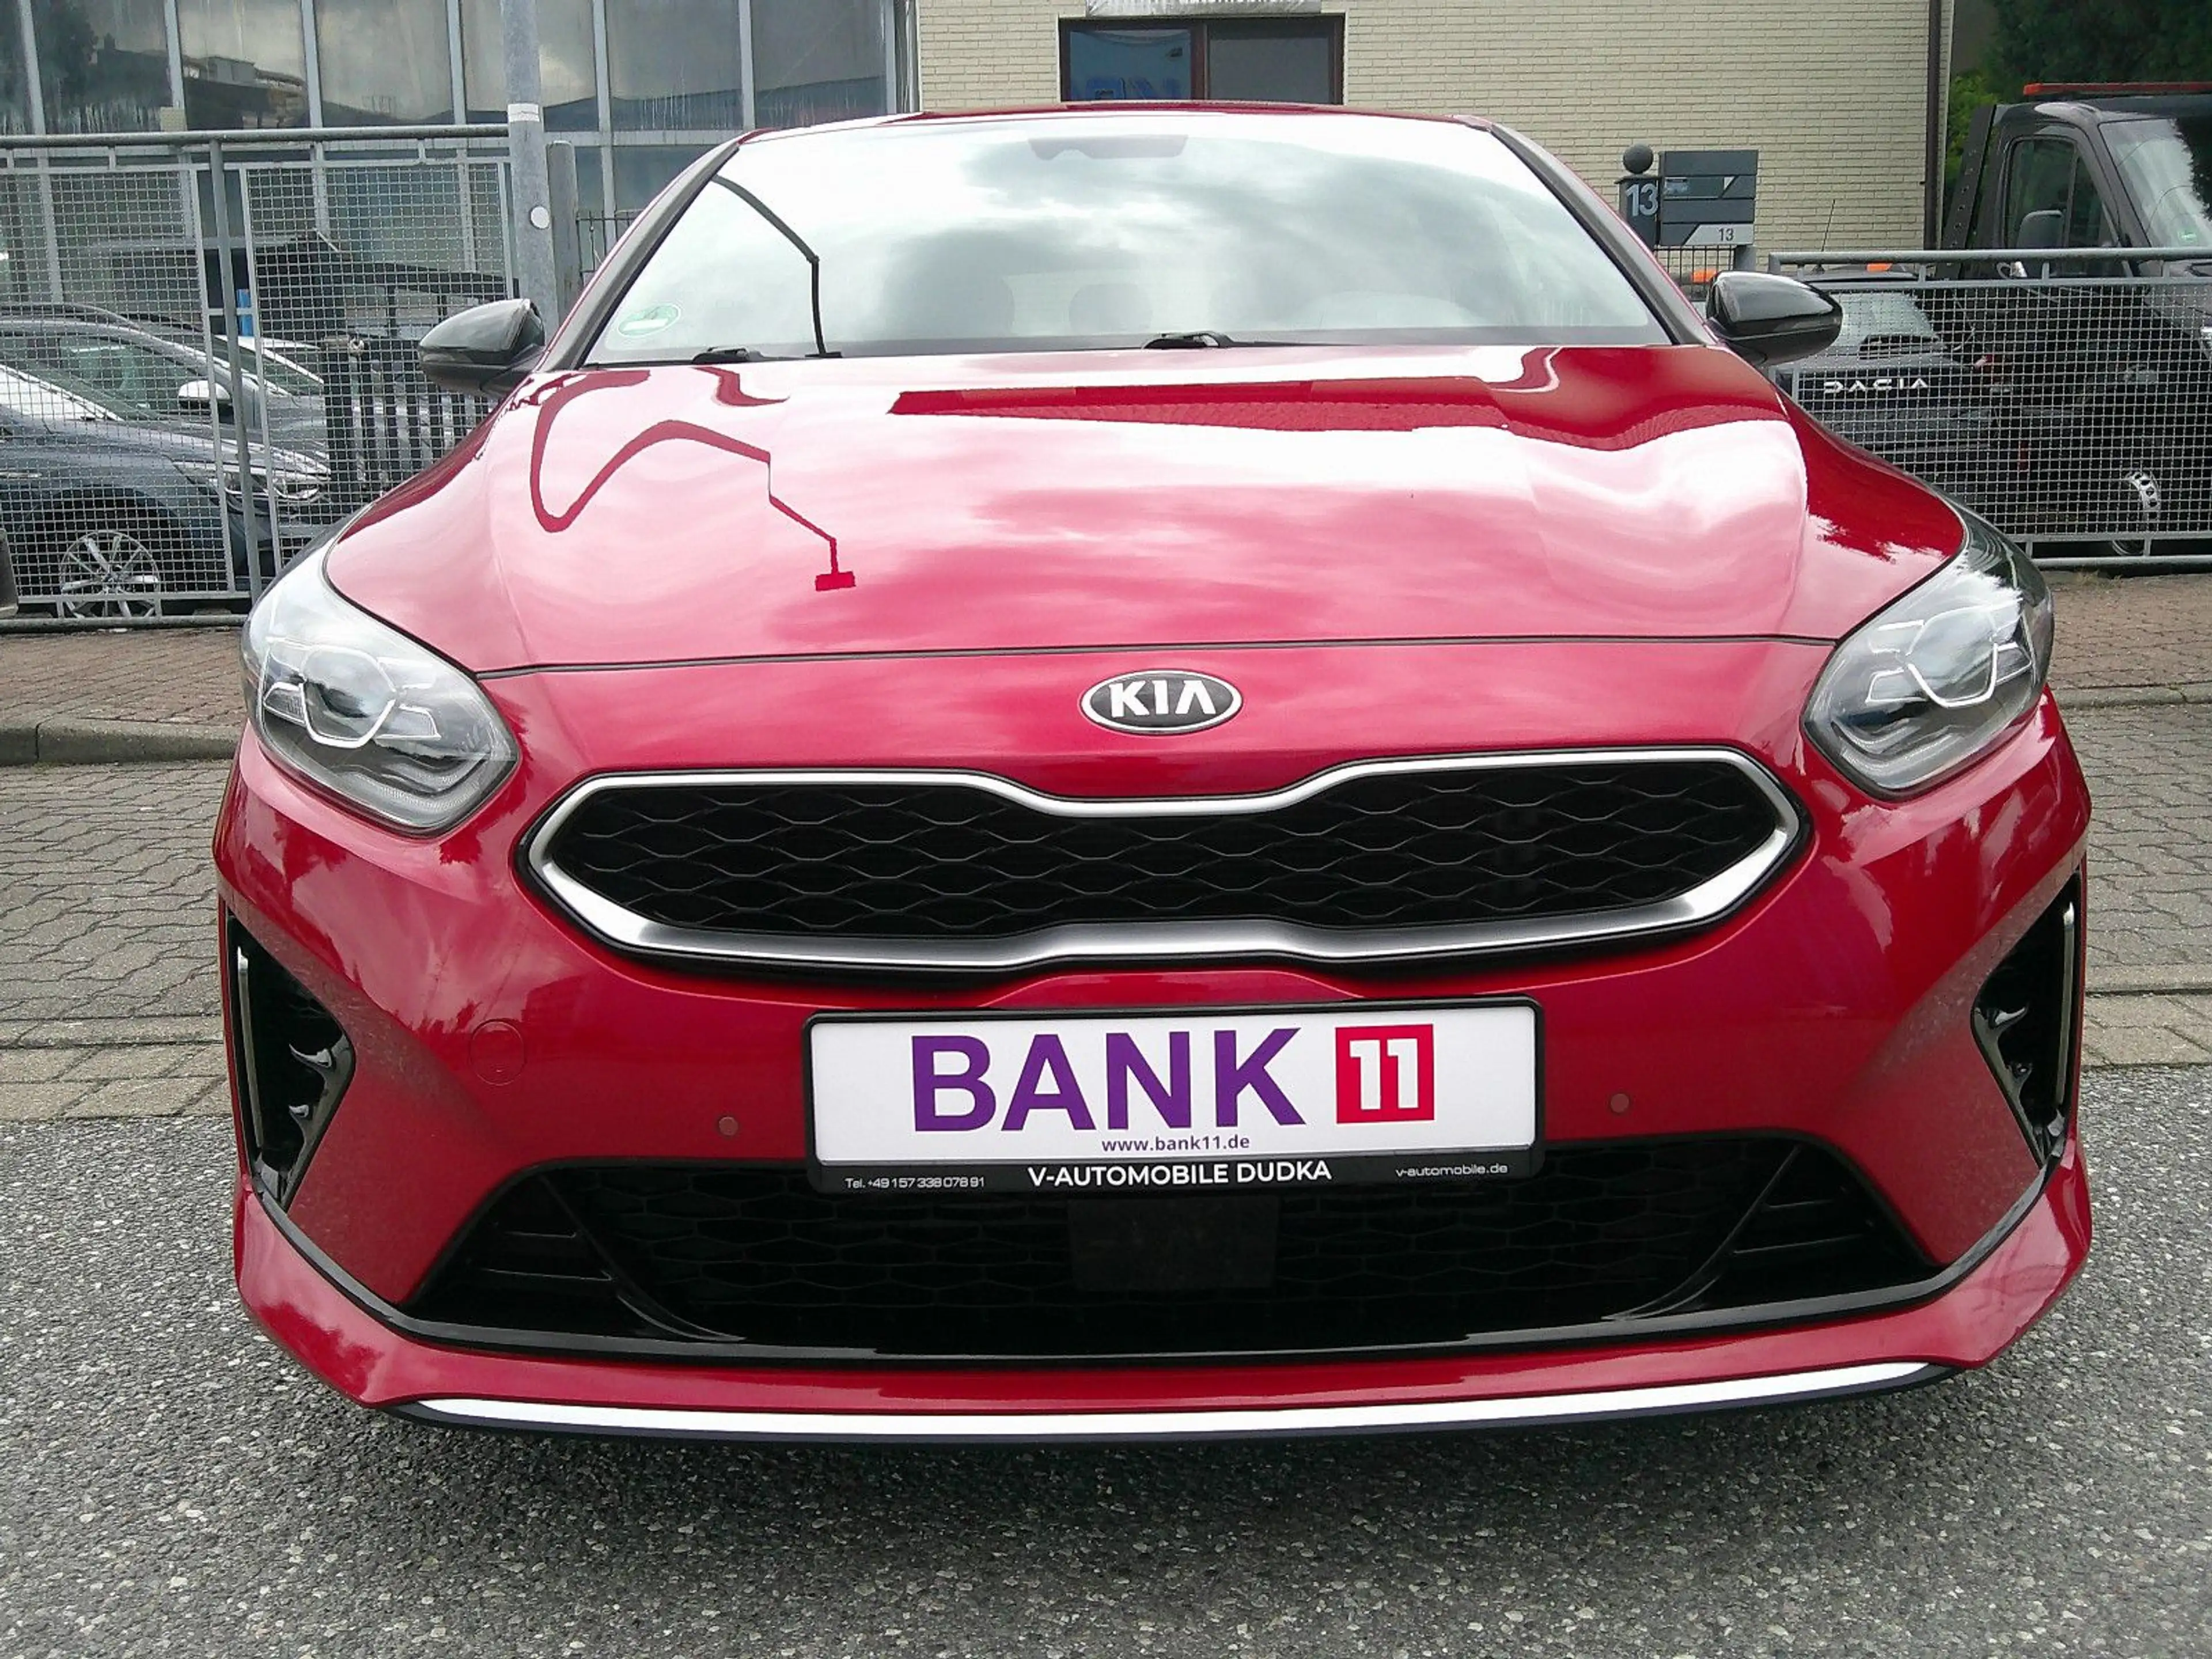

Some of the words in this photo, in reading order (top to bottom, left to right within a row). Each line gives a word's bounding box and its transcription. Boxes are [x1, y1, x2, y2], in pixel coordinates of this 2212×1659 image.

[1625, 183, 1659, 217] 13
[1718, 228, 1734, 242] 13
[1823, 378, 1929, 393] DACIA
[1108, 679, 1217, 718] KIA
[911, 1027, 1306, 1132] BANK
[1349, 1038, 1419, 1111] 11
[1101, 1133, 1250, 1152] www.bank11.de
[1028, 1163, 1229, 1187] V-AUTOMOBILE
[1237, 1160, 1332, 1183] DUDKA
[1395, 1162, 1508, 1177] v-automobile.de
[844, 1177, 865, 1189] Tel.
